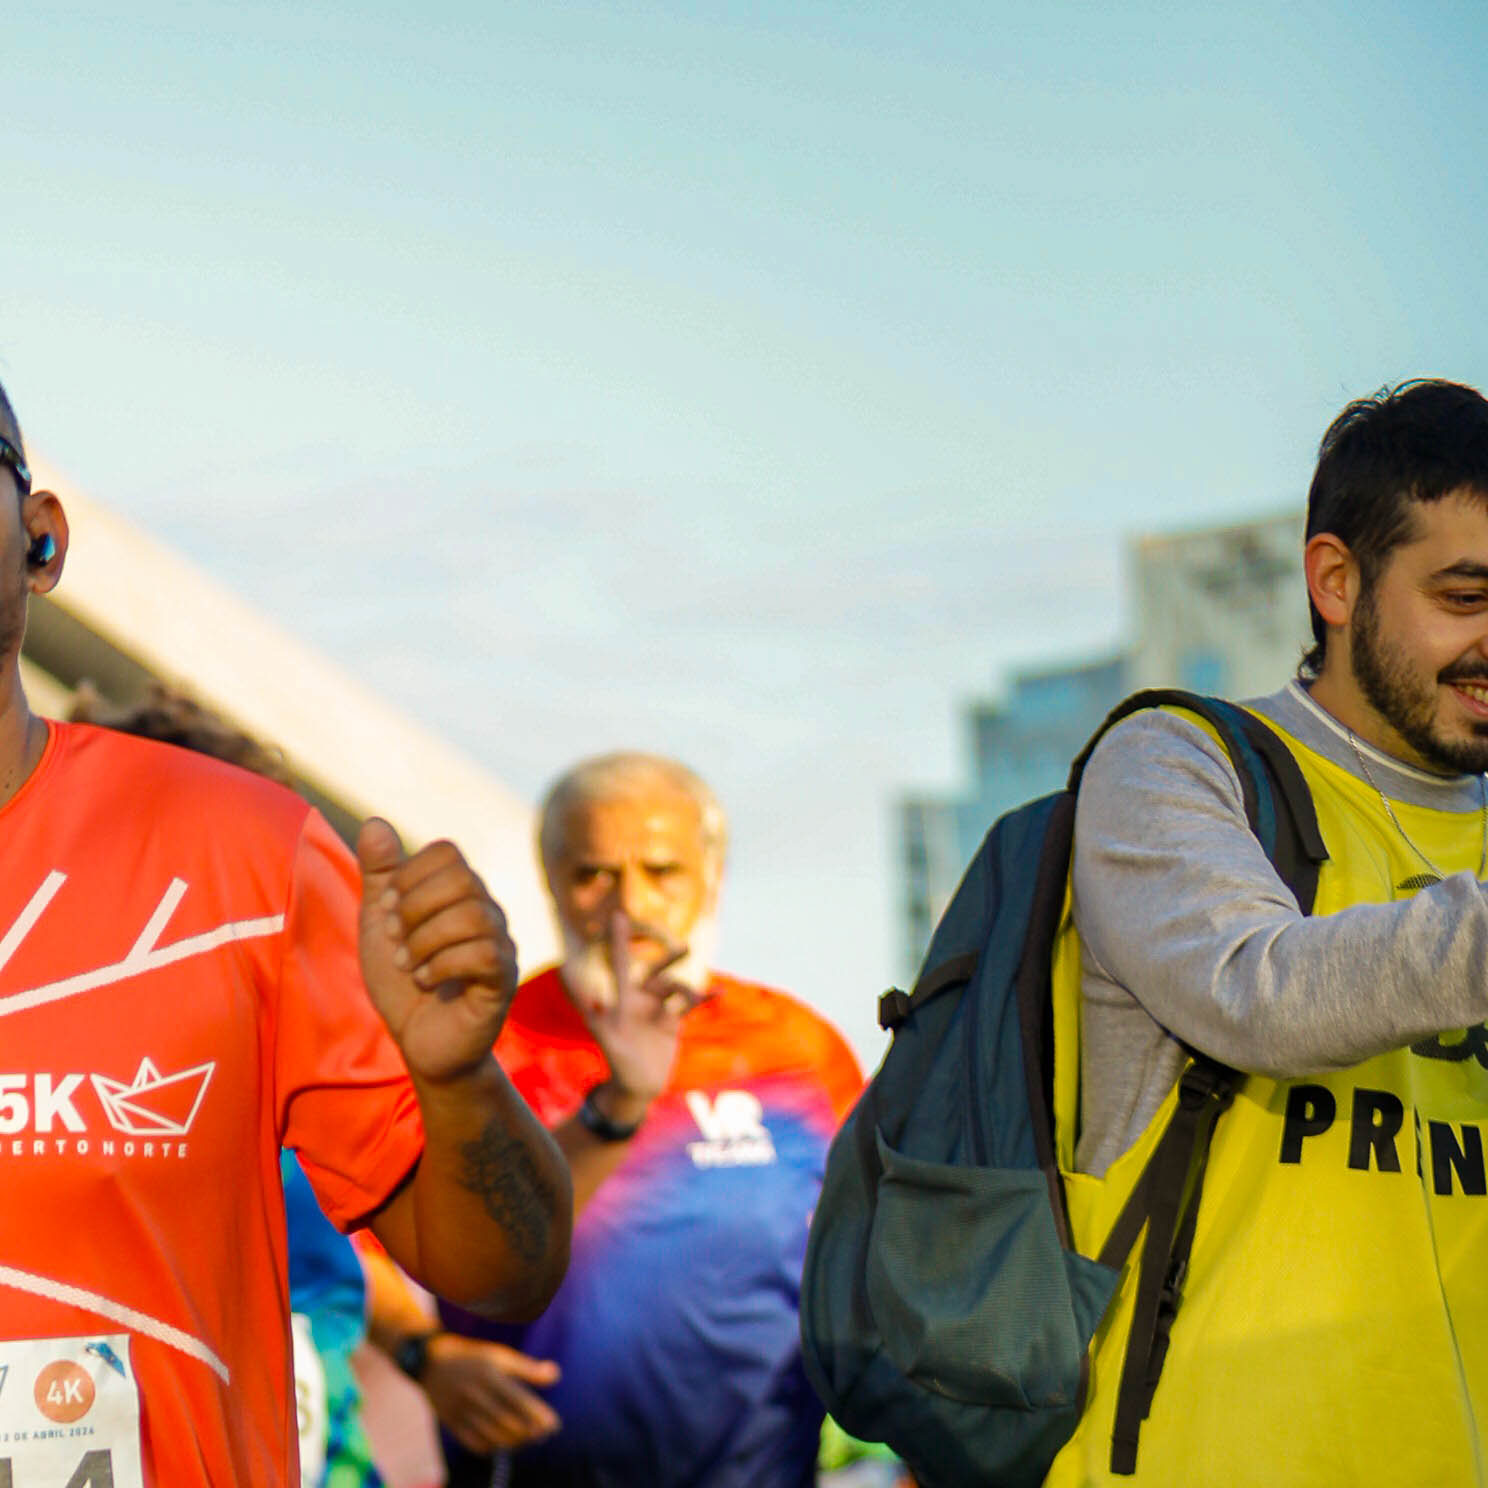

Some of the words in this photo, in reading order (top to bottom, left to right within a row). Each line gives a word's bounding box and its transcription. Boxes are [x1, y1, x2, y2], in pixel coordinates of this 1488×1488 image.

[103, 1140, 188, 1158] NORTE
[1279, 1084, 1488, 1196] PRN
[46, 1378, 84, 1406] 4K
[14, 1431, 28, 1441] DE
[33, 1429, 64, 1440] ABRIL
